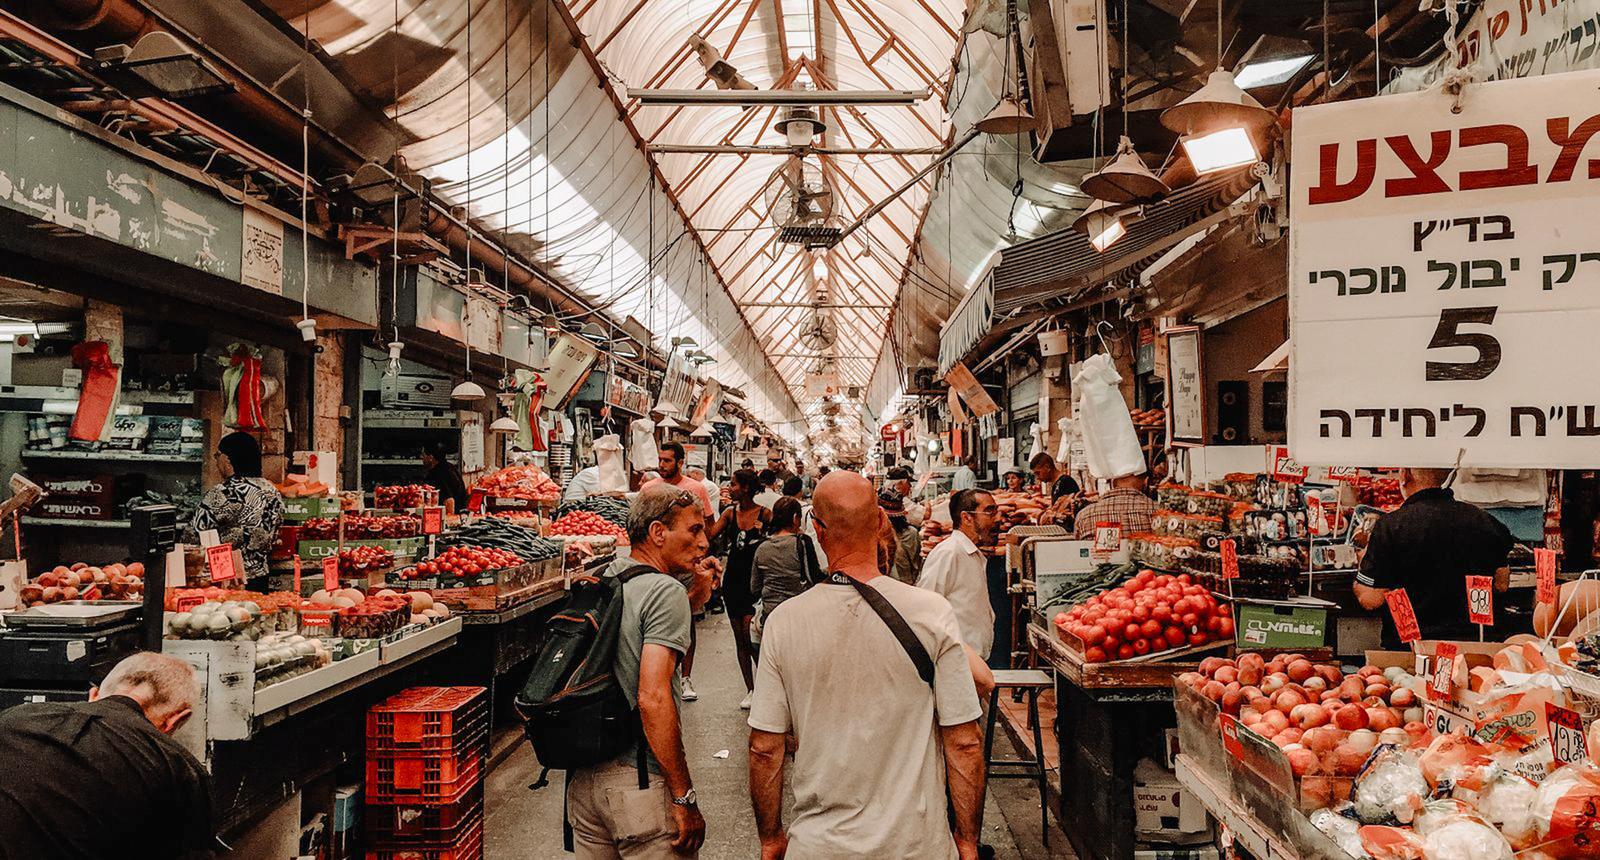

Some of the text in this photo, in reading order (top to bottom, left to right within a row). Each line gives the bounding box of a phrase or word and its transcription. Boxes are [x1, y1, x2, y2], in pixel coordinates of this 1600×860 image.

[1308, 113, 1600, 205] מבצע
[1413, 214, 1515, 252] בד״ץ
[1309, 265, 1407, 296] נוכרי
[1427, 257, 1520, 291] יבול
[1425, 306, 1502, 381] 5
[1319, 403, 1487, 438] ליחידה
